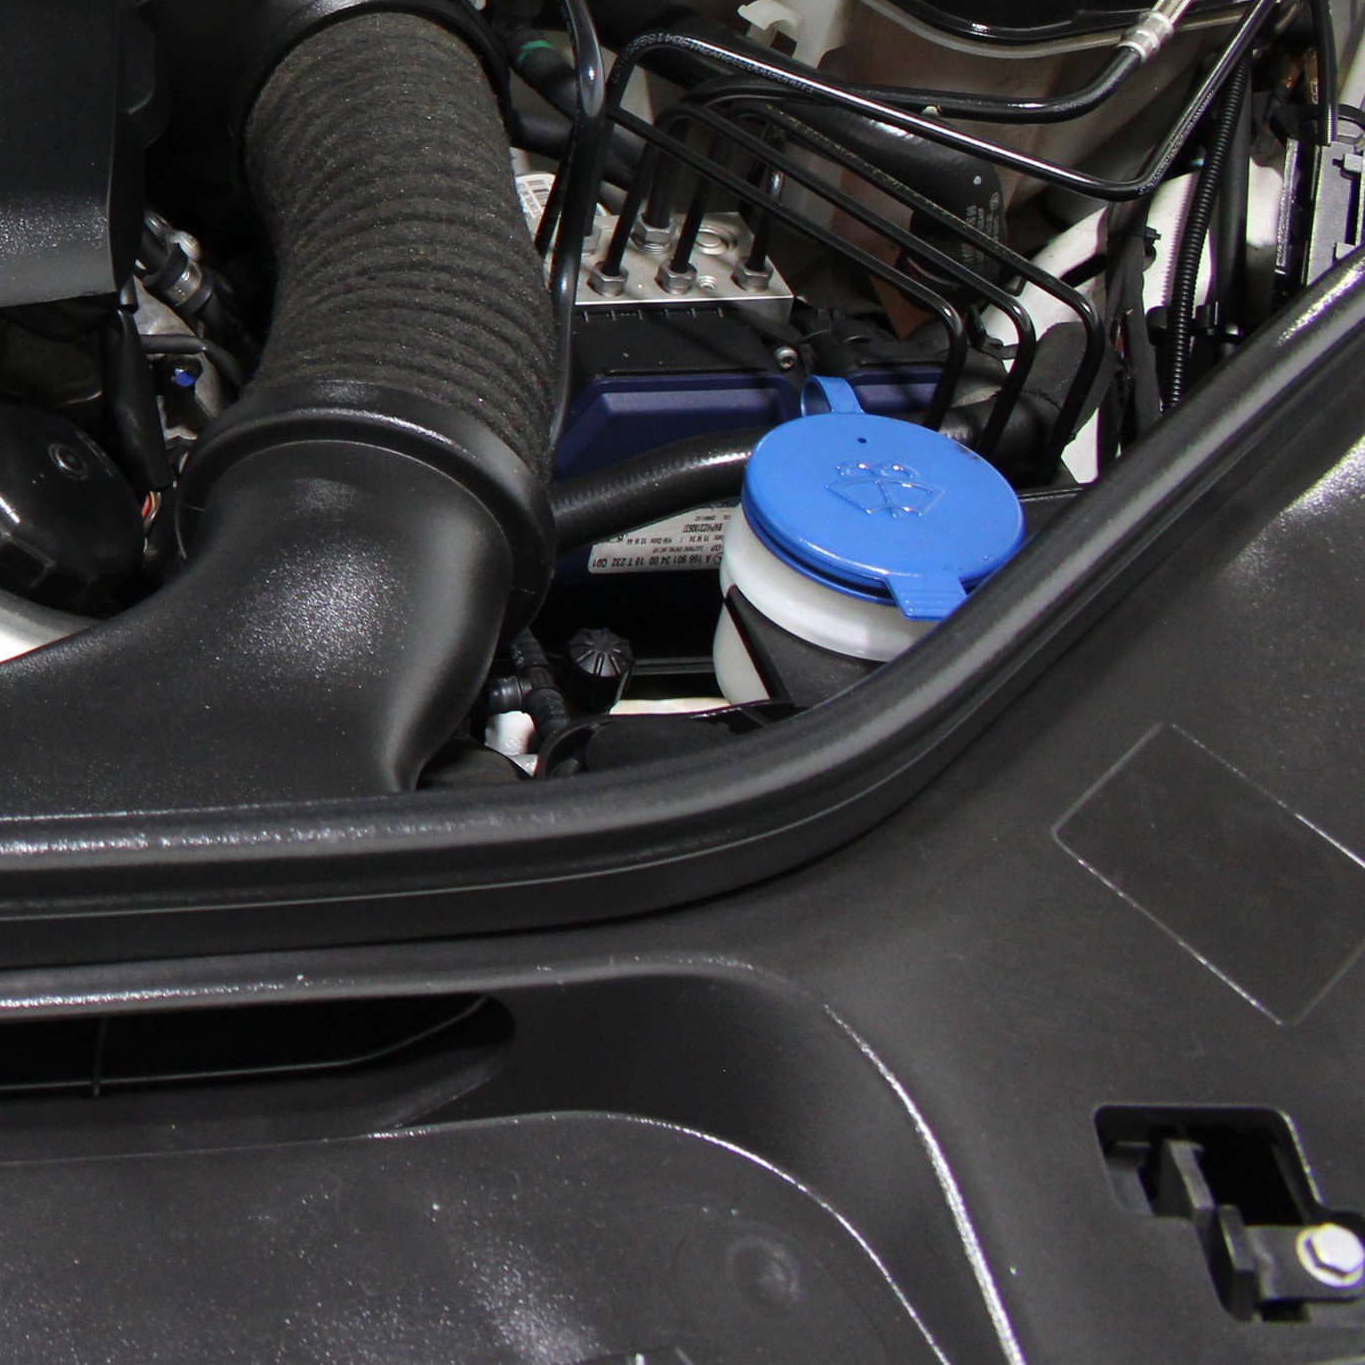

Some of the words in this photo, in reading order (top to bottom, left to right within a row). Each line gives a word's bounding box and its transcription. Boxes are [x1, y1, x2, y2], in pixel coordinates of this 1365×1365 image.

[612, 558, 626, 567] 232
[660, 556, 671, 565] 34
[673, 555, 687, 564] 901
[689, 554, 703, 563] 166
